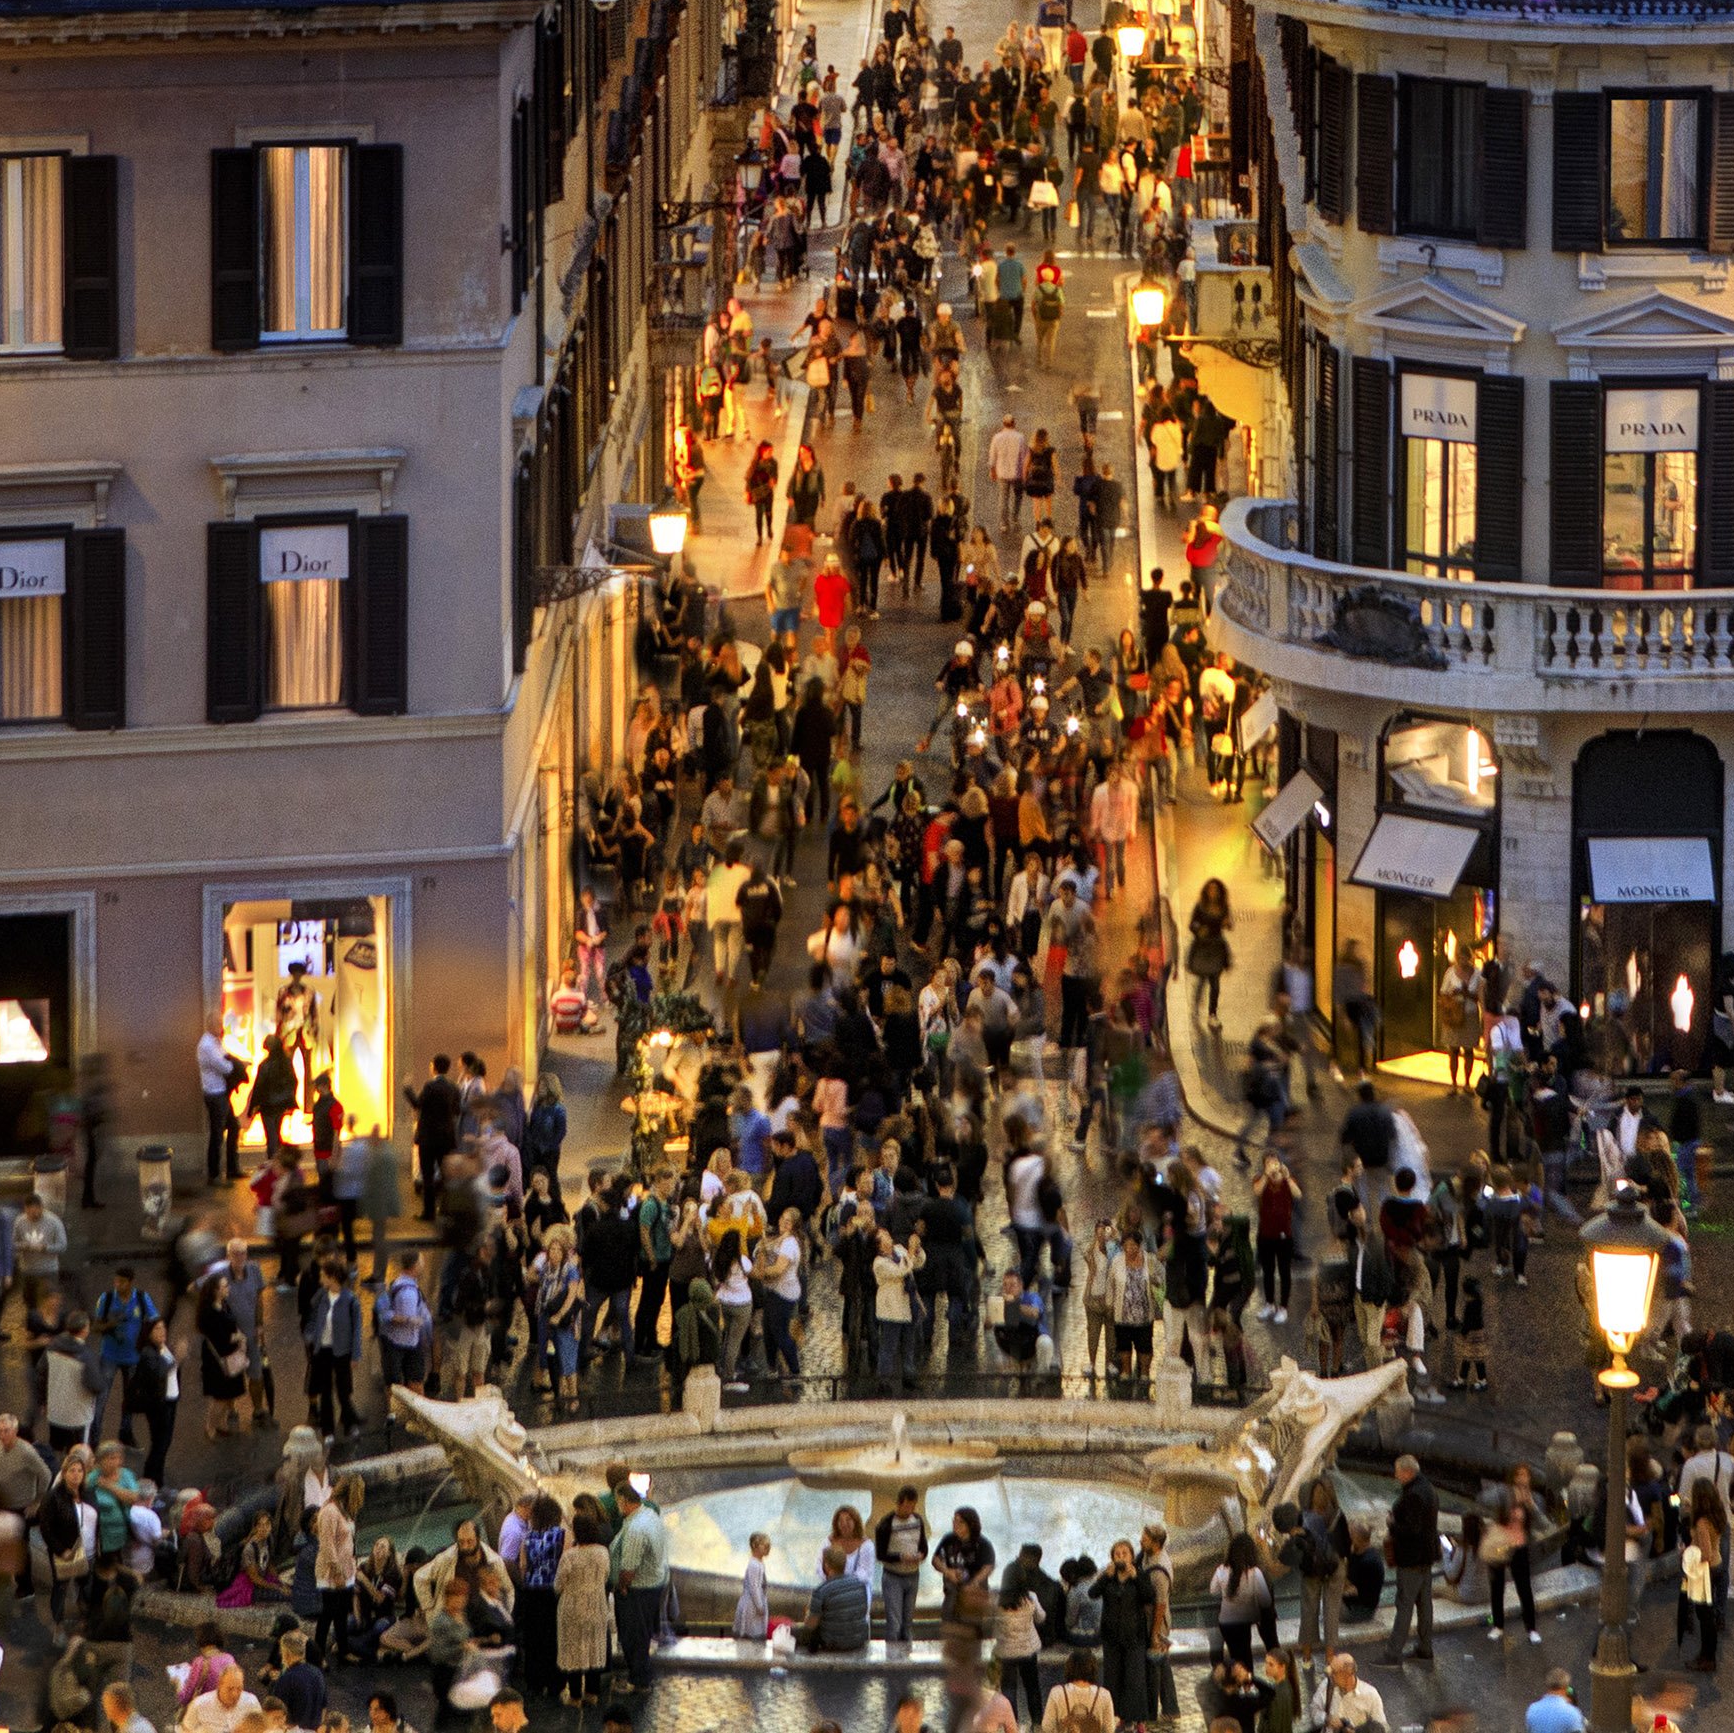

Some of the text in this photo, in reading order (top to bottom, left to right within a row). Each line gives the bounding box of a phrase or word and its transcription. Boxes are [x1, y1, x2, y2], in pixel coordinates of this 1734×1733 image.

[1412, 408, 1468, 428] PRADA
[1619, 422, 1687, 436] PRADA
[280, 550, 332, 574] Dior
[1374, 868, 1435, 887] MONCLER
[1616, 884, 1691, 898] MONCLER
